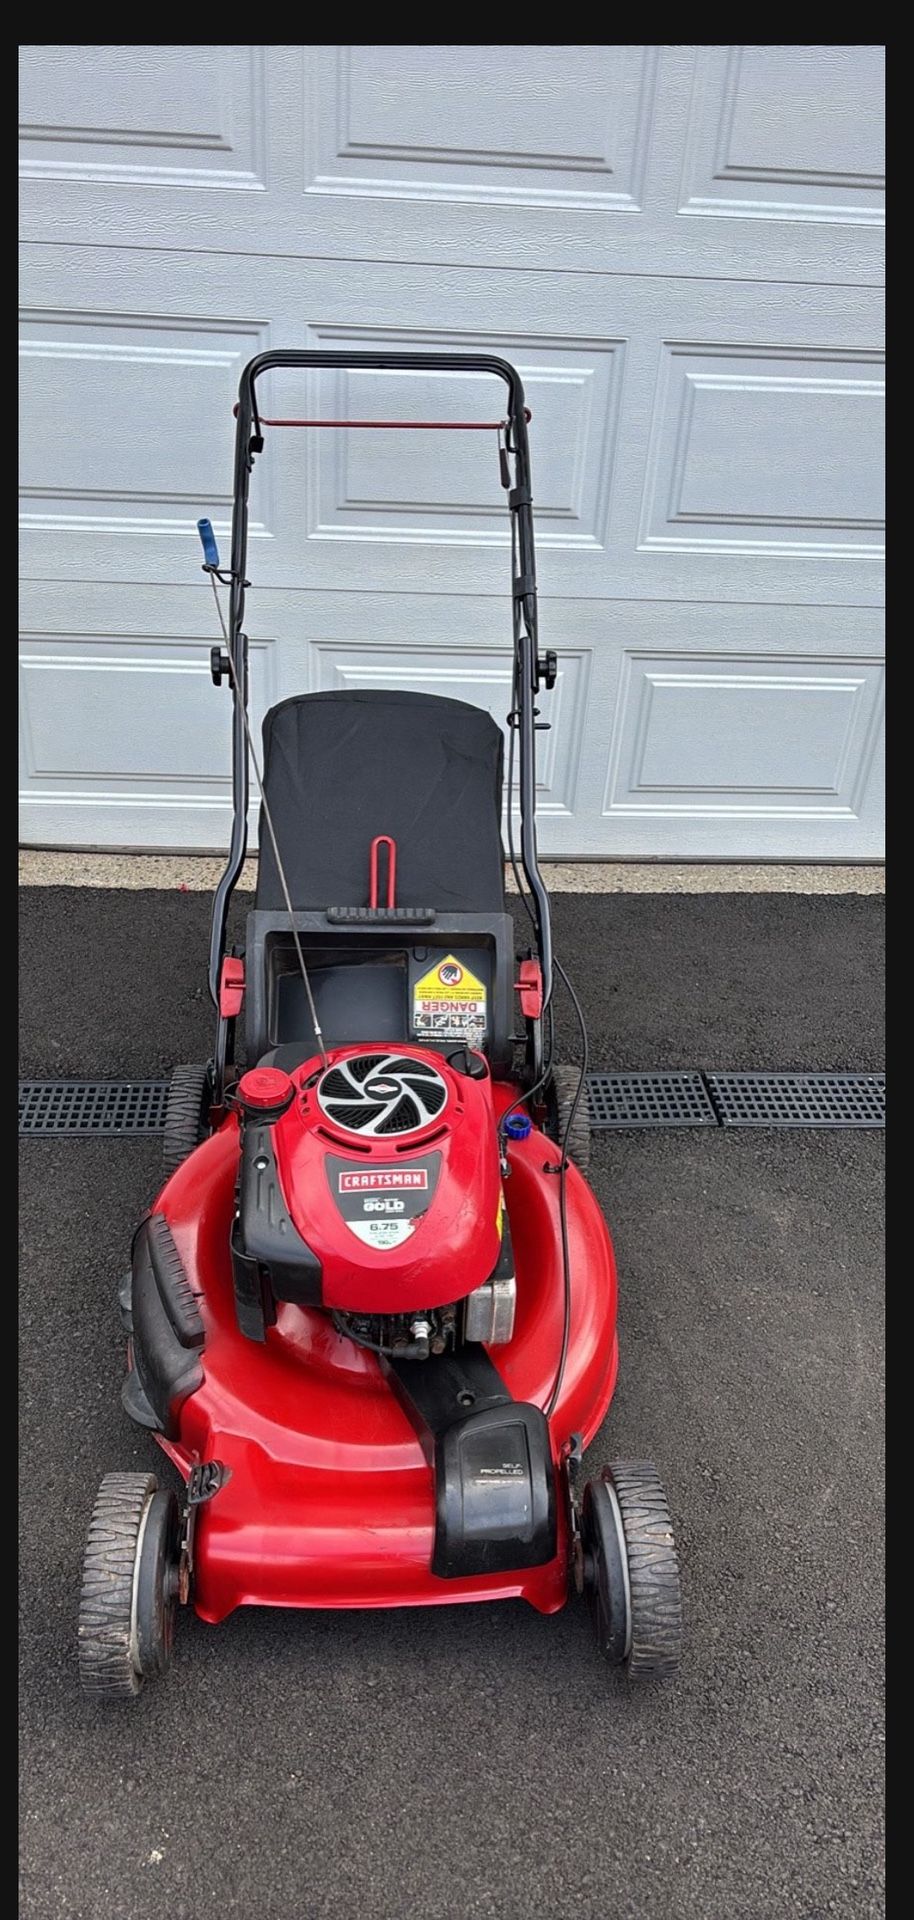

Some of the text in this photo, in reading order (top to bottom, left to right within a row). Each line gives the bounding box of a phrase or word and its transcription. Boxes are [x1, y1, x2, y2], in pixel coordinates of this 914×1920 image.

[422, 1002, 477, 1012] DANGER
[344, 1174, 421, 1187] CRAFTSMAN
[363, 1201, 405, 1212] GOLD
[369, 1223, 399, 1231] 6.75
